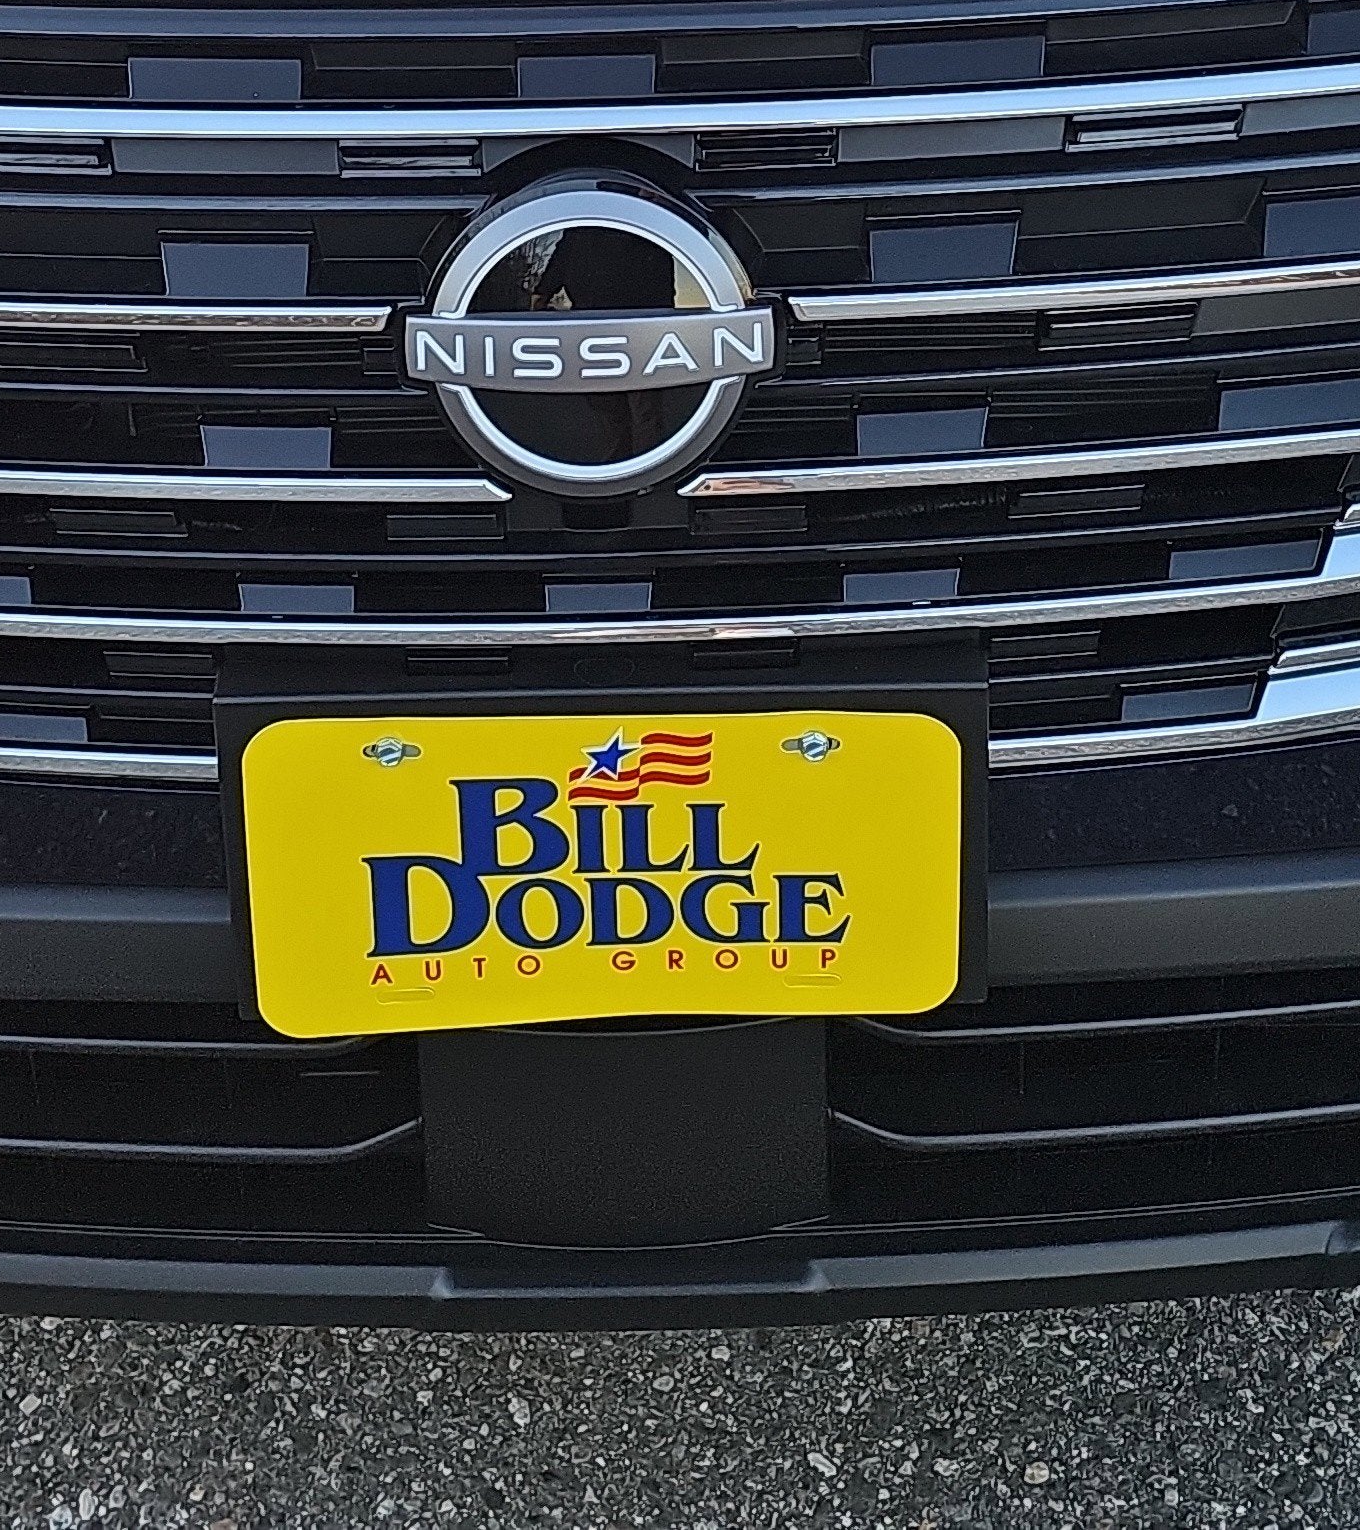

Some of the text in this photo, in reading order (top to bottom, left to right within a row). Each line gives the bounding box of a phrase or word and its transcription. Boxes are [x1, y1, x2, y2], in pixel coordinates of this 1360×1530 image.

[416, 322, 764, 378] NISSAN
[448, 778, 761, 875] BILL
[361, 855, 852, 958] DODGE
[371, 947, 837, 986] AUTO GROUP
